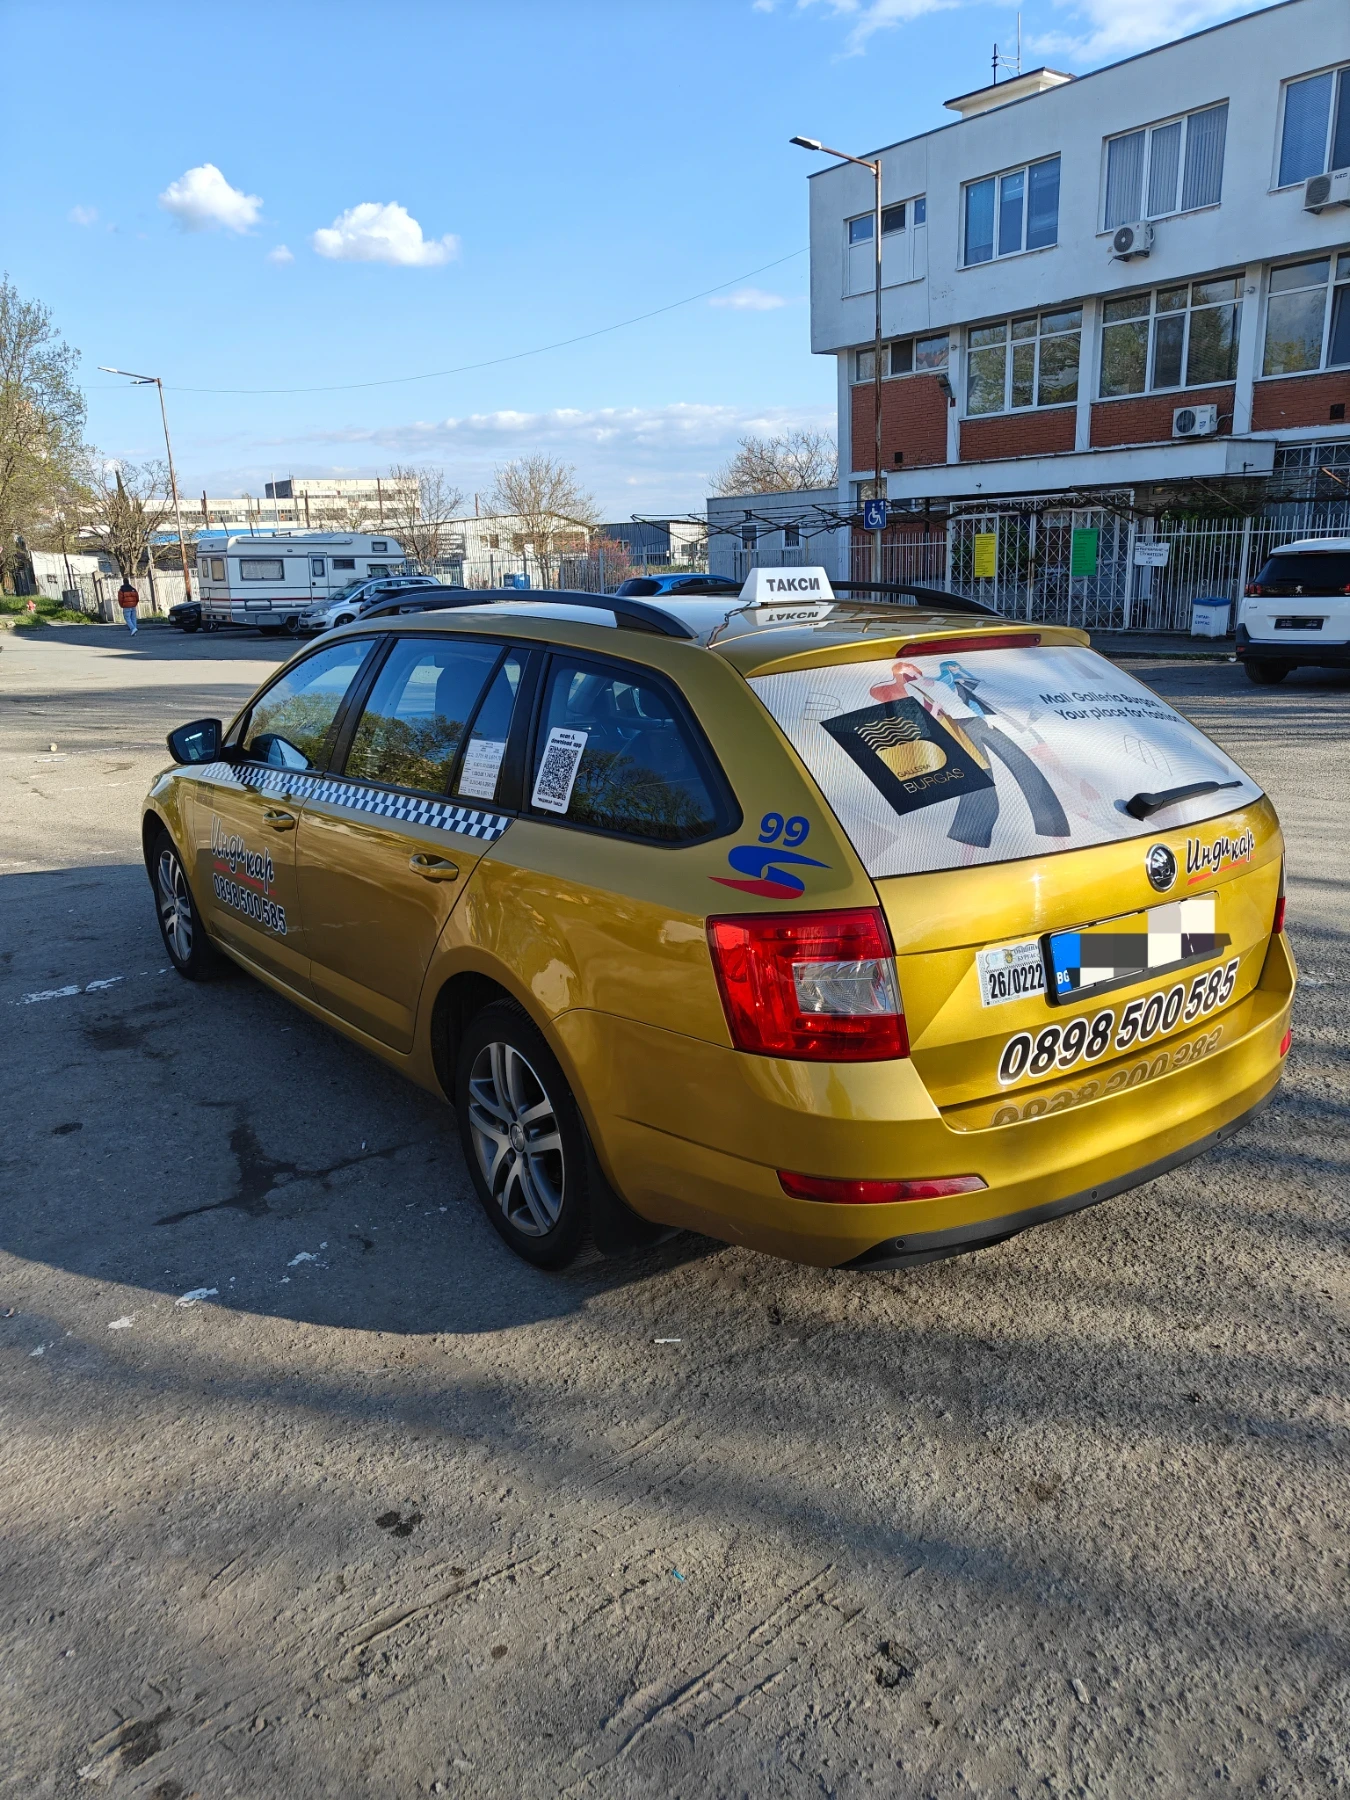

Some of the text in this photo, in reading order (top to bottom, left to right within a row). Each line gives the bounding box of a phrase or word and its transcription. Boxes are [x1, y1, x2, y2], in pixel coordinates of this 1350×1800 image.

[766, 577, 821, 592] ТАКСИ
[1039, 691, 1074, 705] Mall
[1072, 691, 1125, 703] Galleria
[1053, 708, 1090, 721] Your
[1089, 706, 1128, 721] place
[1123, 706, 1145, 718] for
[550, 738, 573, 747] download
[903, 768, 965, 794] BURGAS
[758, 812, 810, 847] 99
[213, 873, 287, 935] 0898 500 585
[988, 963, 1045, 999] 26/0222
[1056, 969, 1070, 985] BG
[998, 957, 1240, 1086] 0898 500 585
